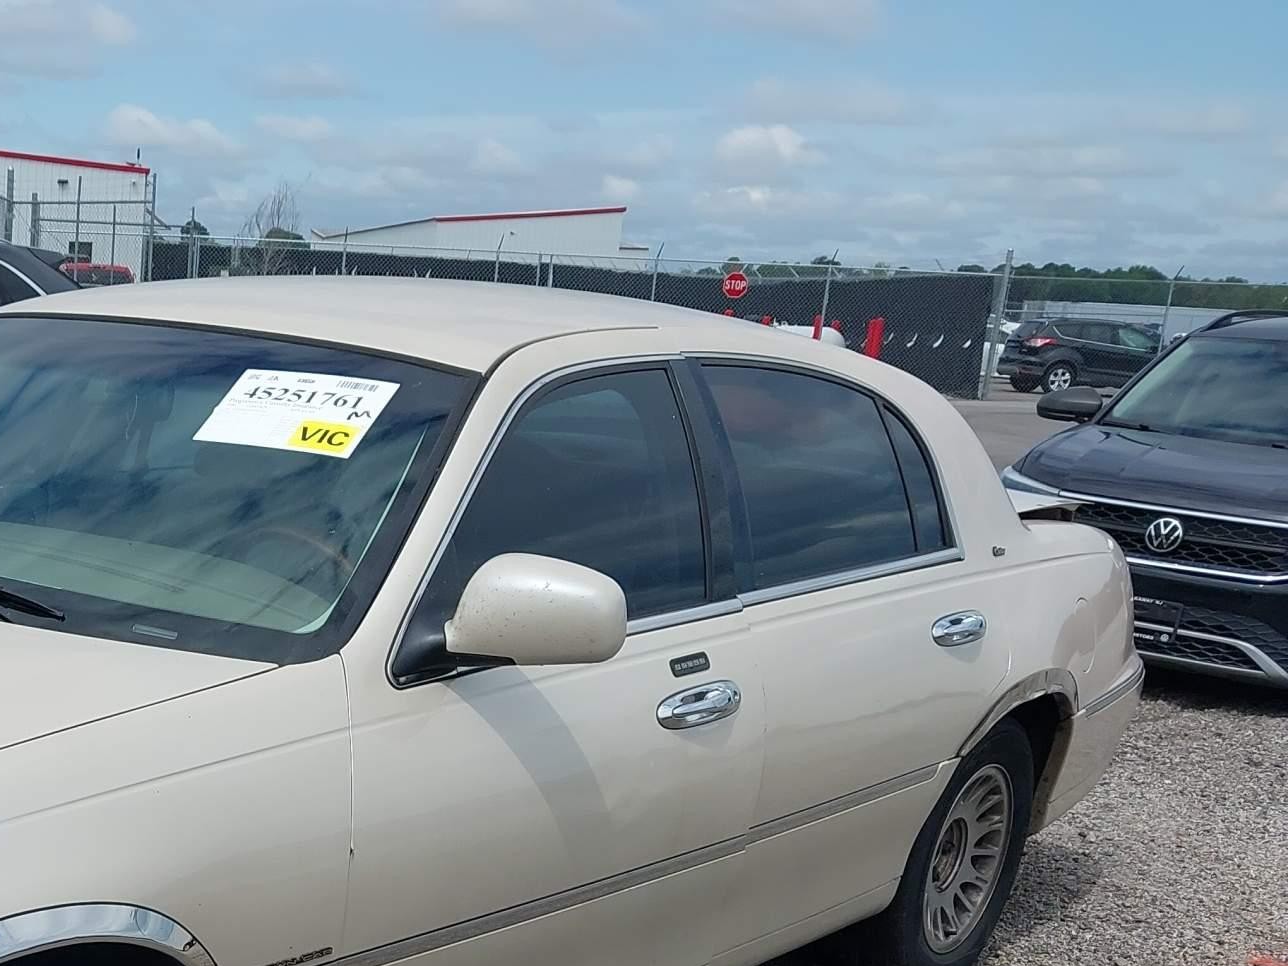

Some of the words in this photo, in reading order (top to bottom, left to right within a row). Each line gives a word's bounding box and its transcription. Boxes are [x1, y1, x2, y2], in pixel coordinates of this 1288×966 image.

[724, 279, 747, 291] STOP
[243, 386, 363, 410] 45251761
[301, 426, 350, 447] VIC
